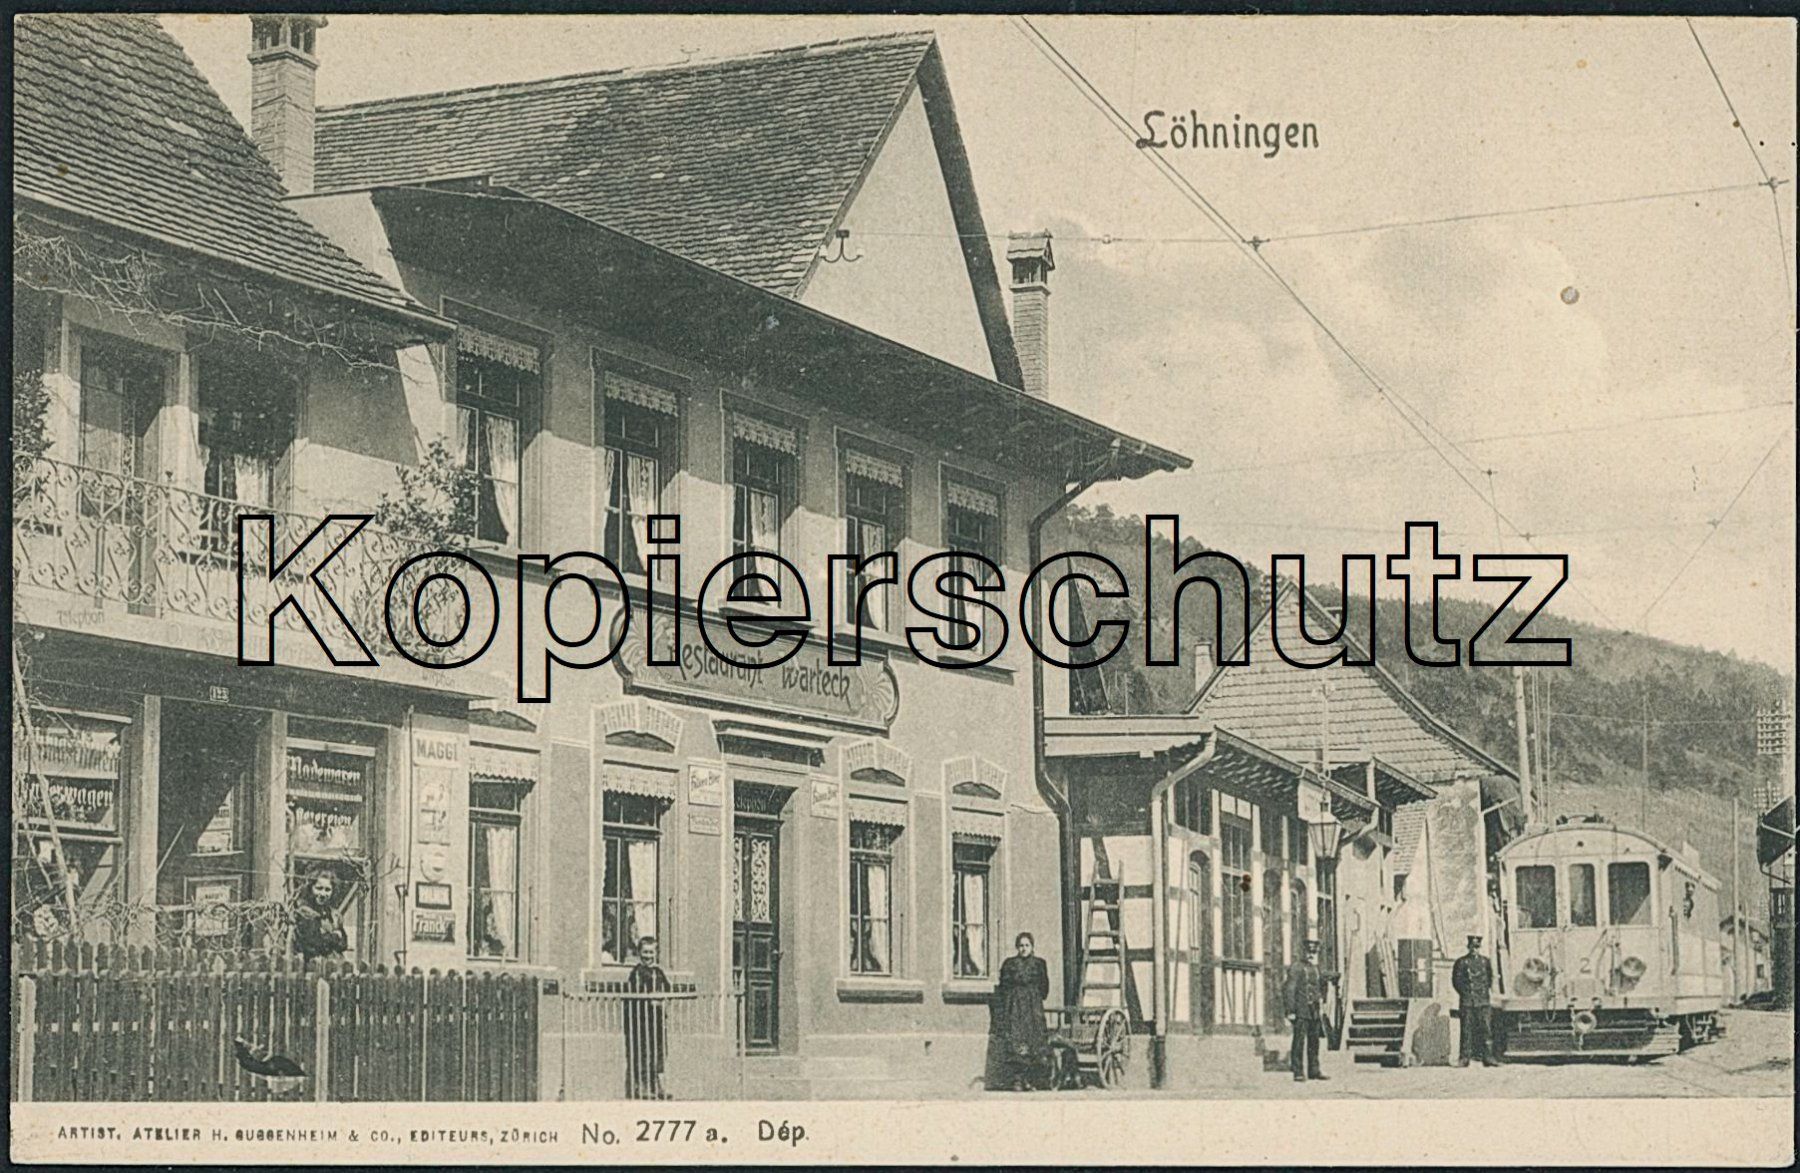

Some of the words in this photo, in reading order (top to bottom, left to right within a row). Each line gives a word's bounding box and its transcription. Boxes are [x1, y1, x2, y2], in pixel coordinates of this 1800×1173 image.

[667, 643, 763, 688] Restaurant
[416, 738, 459, 762] MAGGI
[1579, 957, 1592, 974] 2
